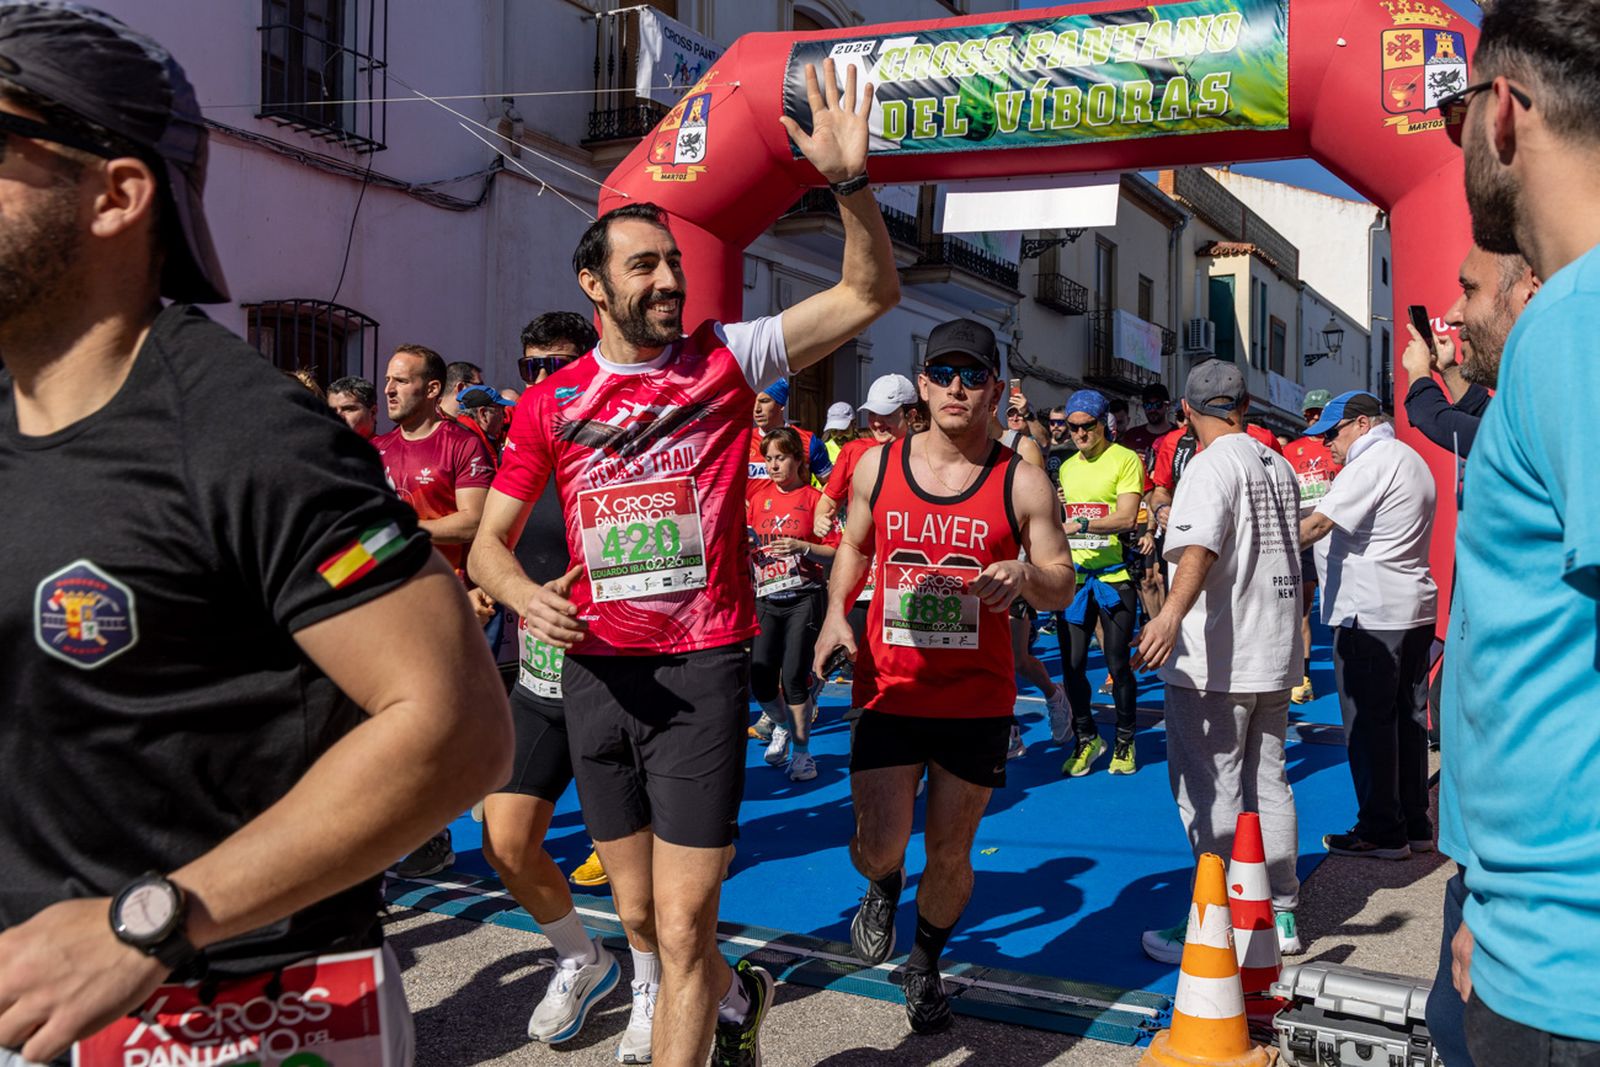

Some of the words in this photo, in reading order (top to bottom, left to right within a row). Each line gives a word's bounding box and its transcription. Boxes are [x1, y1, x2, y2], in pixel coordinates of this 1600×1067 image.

[664, 26, 692, 52] CROSS
[693, 42, 720, 61] PANT
[834, 43, 872, 55] 2026
[876, 35, 1012, 84] CROSS
[1018, 12, 1243, 73] PANTANO
[879, 97, 970, 142] DEL
[994, 70, 1232, 134] VÍBORAS
[1408, 119, 1445, 132] MARTOS
[660, 173, 688, 181] MARTOS
[651, 446, 696, 472] TRAIL
[593, 494, 611, 517] X
[612, 491, 677, 514] CROSS
[595, 508, 664, 531] PANTANO
[886, 511, 989, 551] PLAYER
[602, 518, 681, 565] 420
[591, 566, 629, 579] EDUARDO
[899, 567, 913, 584] X
[915, 573, 964, 588] CROSS
[898, 583, 952, 599] PANTANO
[124, 996, 172, 1047] X
[181, 988, 333, 1037] CROSS
[123, 1028, 301, 1067] PANTANO
[304, 1029, 334, 1046] DEL
